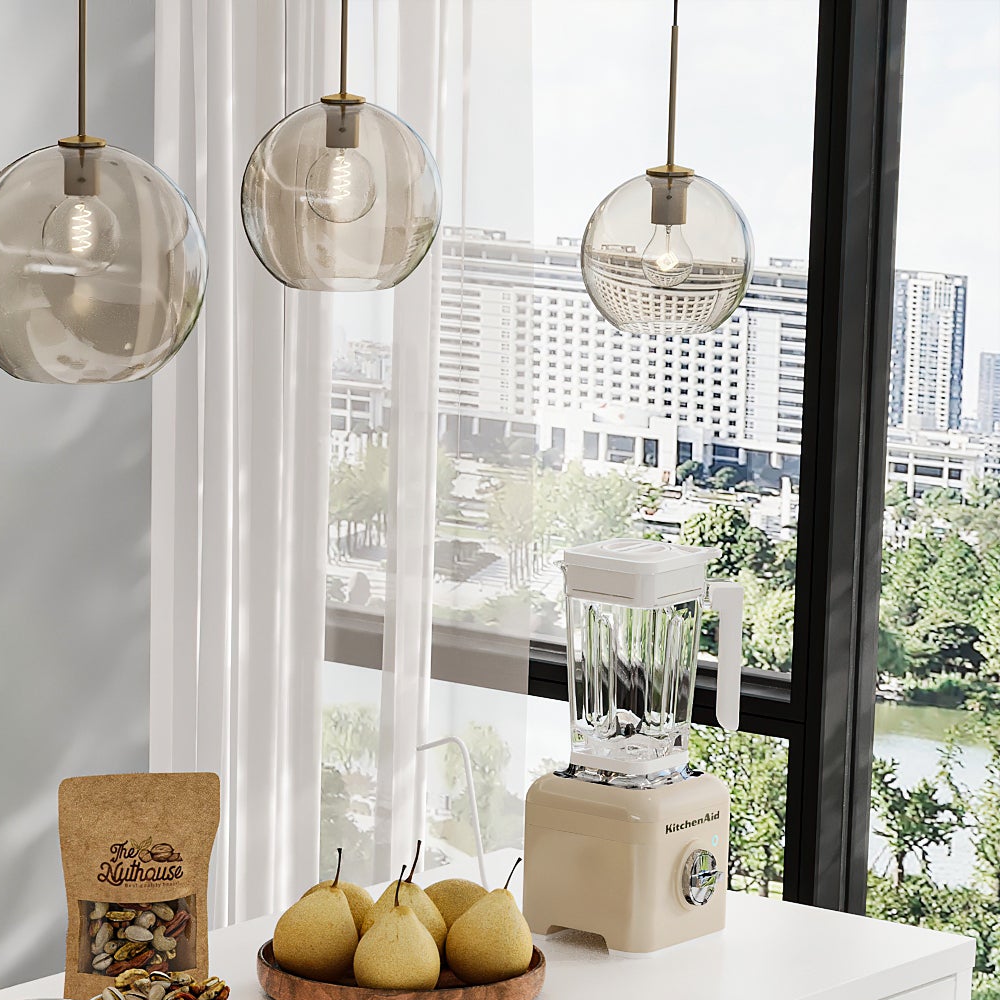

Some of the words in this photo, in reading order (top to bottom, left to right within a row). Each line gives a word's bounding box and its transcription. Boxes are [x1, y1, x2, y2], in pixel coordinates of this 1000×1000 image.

[665, 810, 720, 835] KitchenAid
[110, 840, 139, 863] The
[97, 860, 183, 886] Nuthouse
